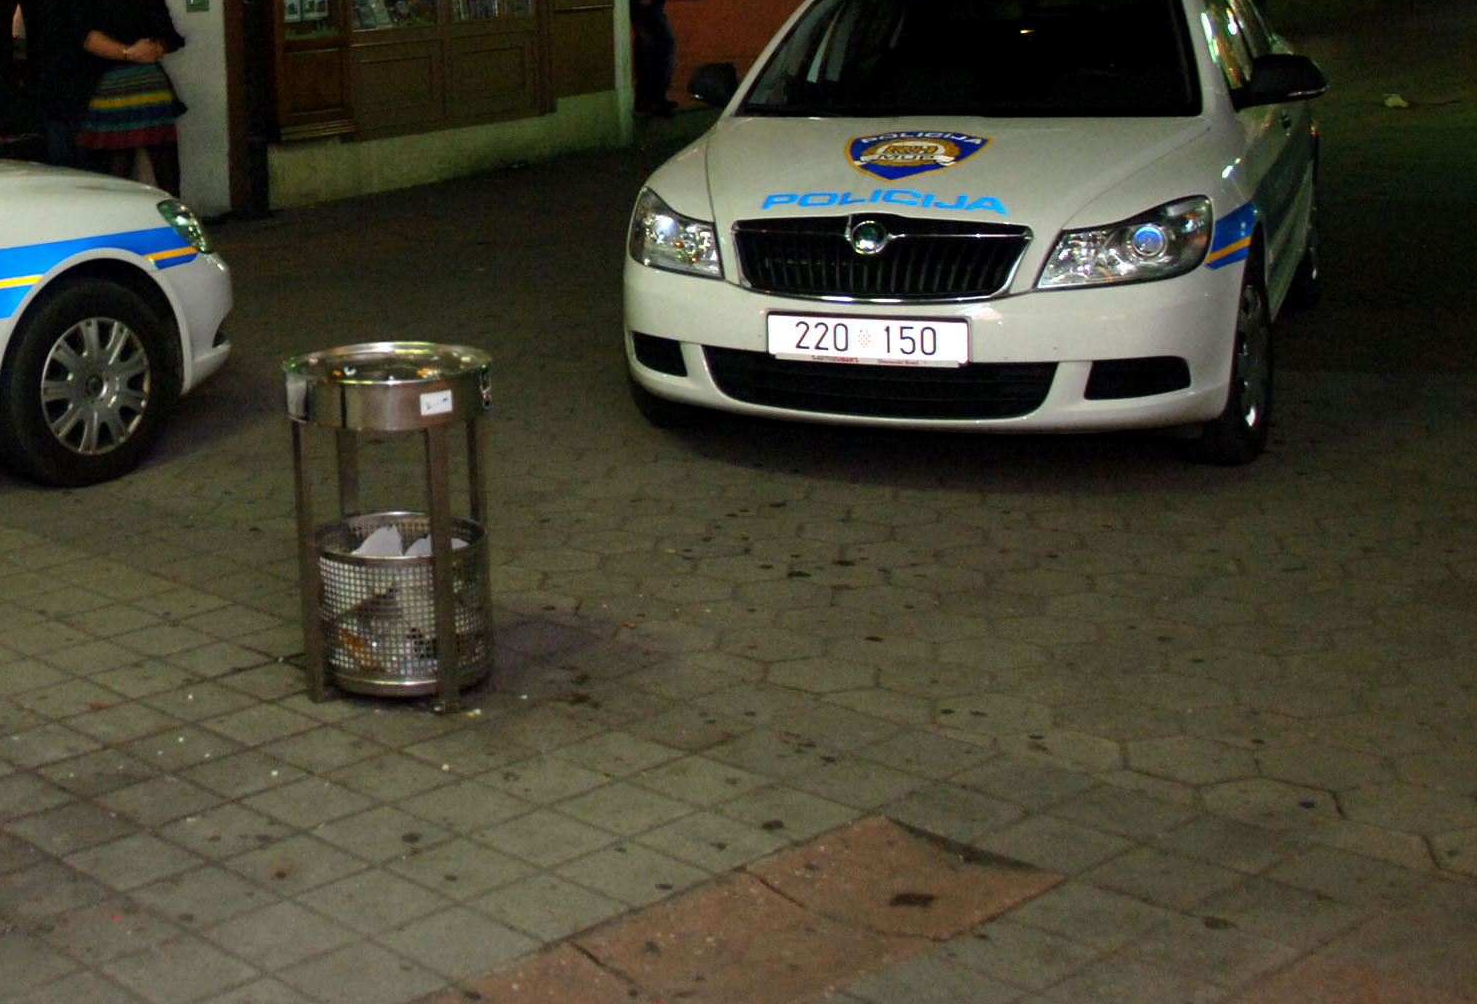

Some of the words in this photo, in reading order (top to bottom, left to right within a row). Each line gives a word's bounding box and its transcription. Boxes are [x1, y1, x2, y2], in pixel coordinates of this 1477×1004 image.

[861, 132, 983, 145] POLICIJA
[761, 189, 1008, 214] POLICIJA
[795, 321, 849, 352] 220
[884, 325, 937, 356] 150
